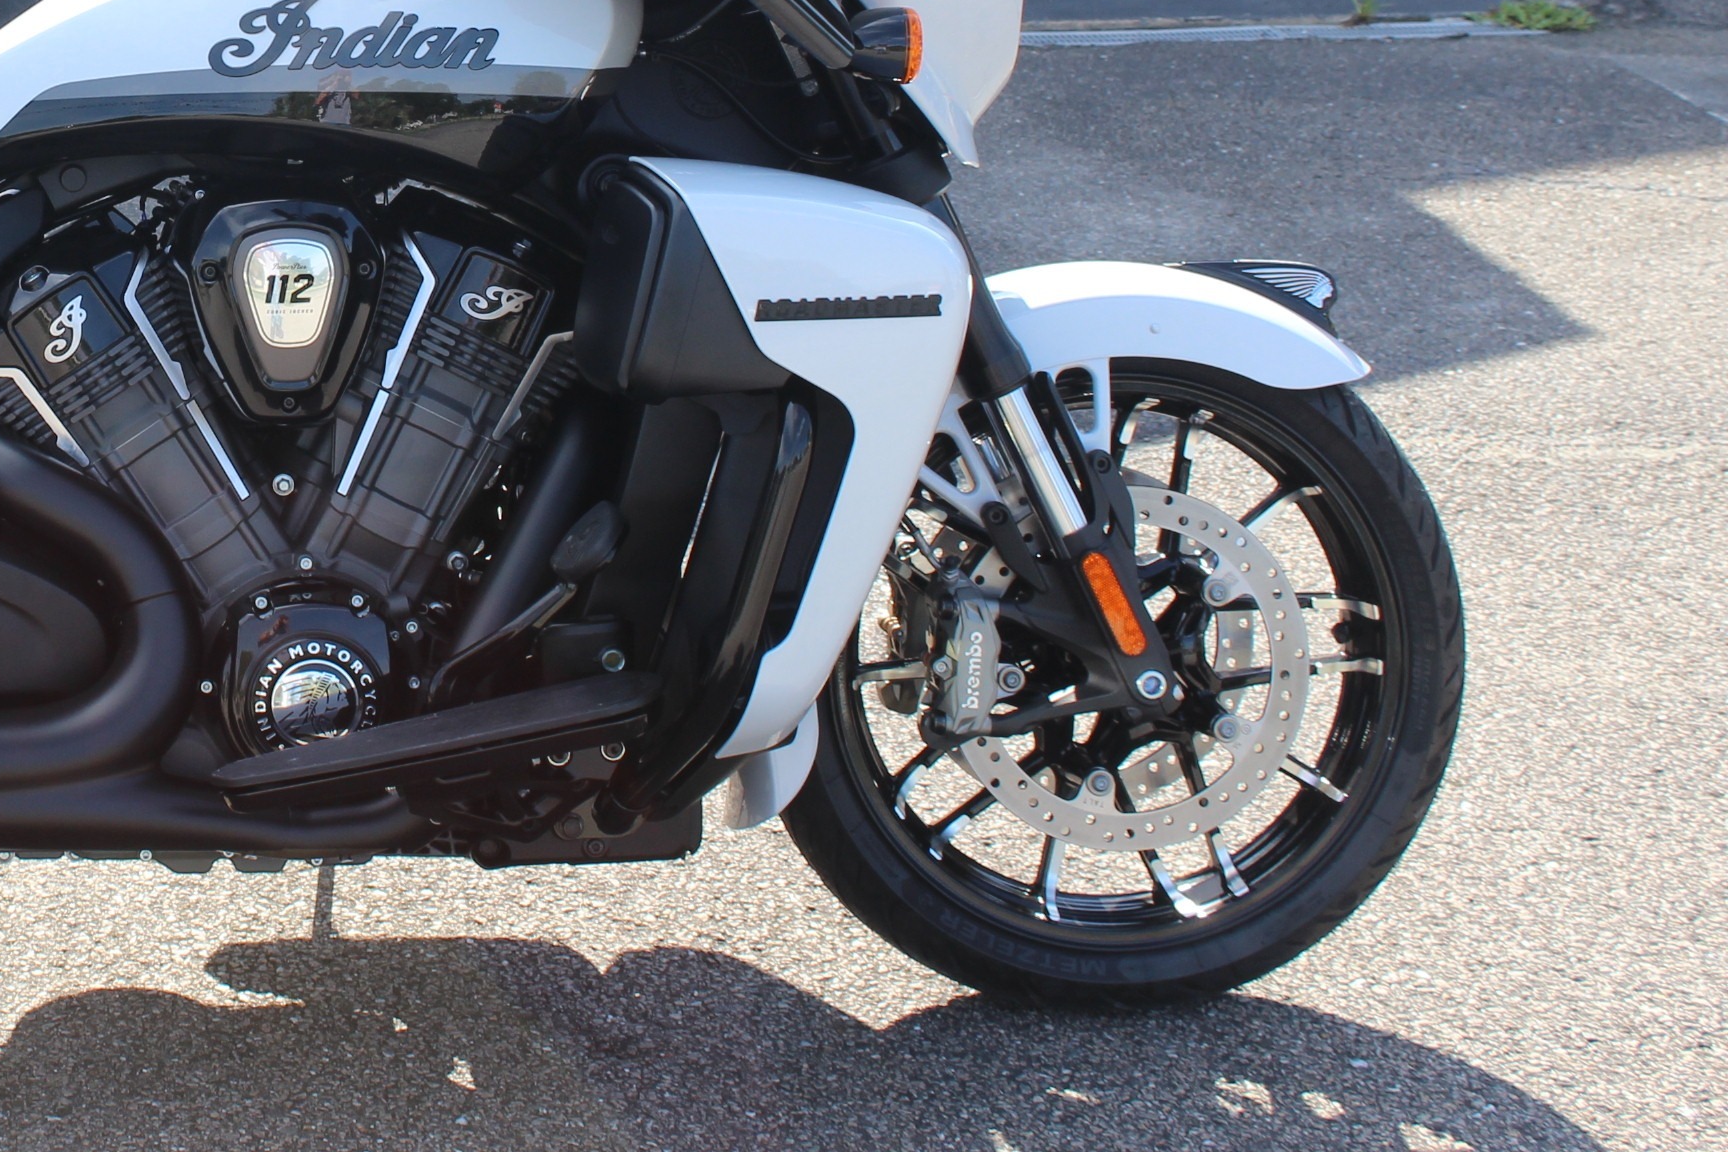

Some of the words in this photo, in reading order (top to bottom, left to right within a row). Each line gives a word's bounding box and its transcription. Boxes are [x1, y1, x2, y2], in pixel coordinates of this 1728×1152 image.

[266, 273, 315, 304] 112
[755, 294, 942, 322] ROADMASTER
[255, 658, 284, 742] INDIAN
[287, 641, 377, 729] MOTORCYCL
[961, 631, 983, 709] brembo
[937, 908, 1108, 977] METZELER
